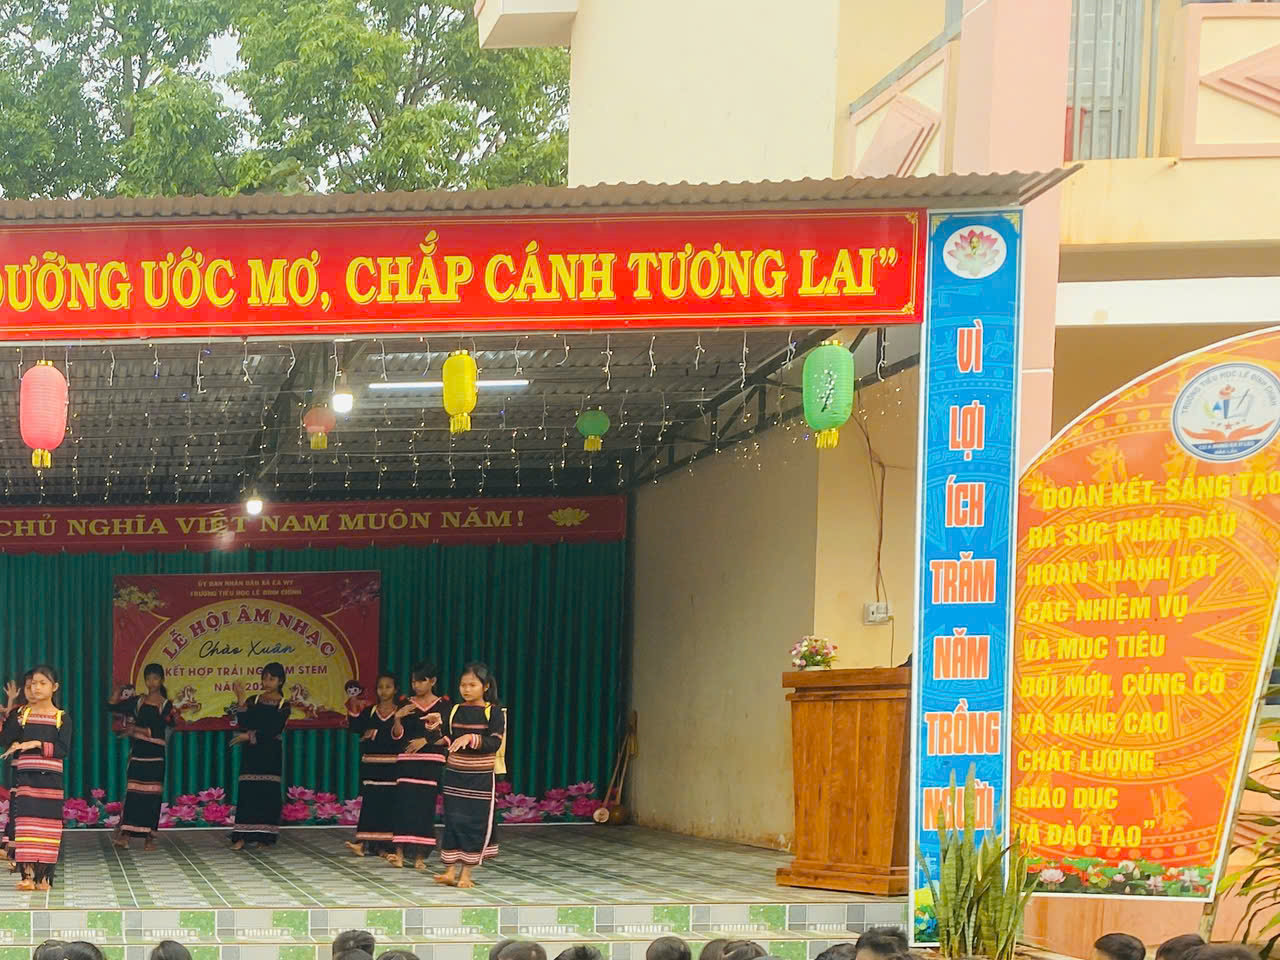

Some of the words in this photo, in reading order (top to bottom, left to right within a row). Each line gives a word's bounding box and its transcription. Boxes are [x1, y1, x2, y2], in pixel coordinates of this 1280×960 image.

[141, 245, 237, 309] ƯỚC
[248, 249, 331, 312] MƠ,
[345, 229, 475, 304] CHẮP
[484, 239, 618, 303] CÁNH
[626, 242, 789, 299] TƯƠNG
[797, 246, 898, 297] LAI”
[949, 400, 986, 461] LỢI
[945, 474, 986, 528] ÍCH
[1112, 473, 1158, 505] KẾT,
[1165, 473, 1232, 501] SÁNG
[1239, 470, 1280, 501] TẠO
[66, 513, 169, 537] NGHĨA
[175, 511, 252, 536] VIỆT
[260, 513, 330, 532] NAM
[338, 508, 432, 531] MUÔN
[1028, 525, 1056, 549] RA
[1064, 519, 1109, 546] SỨC
[1116, 510, 1180, 543] PHẤN
[930, 551, 997, 605] TRĂM
[1026, 558, 1088, 586] HOÀN
[1095, 554, 1170, 583] THÀNH
[1177, 546, 1221, 579] TỐT
[1024, 596, 1070, 624] CÁC
[1076, 592, 1152, 625] NHIỆM
[1158, 594, 1189, 623] VỤ
[162, 629, 189, 660] LỄ
[189, 611, 231, 638] HỘI
[236, 604, 271, 624] ÂM
[276, 611, 337, 657] NHẠC
[199, 640, 243, 659] Chào
[247, 640, 297, 657] Xuân
[1022, 632, 1051, 661] VÀ
[1057, 635, 1109, 665] MỤC
[1115, 630, 1166, 659] TIÊU
[165, 664, 185, 677] KẾT
[188, 665, 214, 679] HỢP
[298, 664, 328, 675] STEM
[933, 627, 991, 681] NĂM
[1020, 667, 1058, 699] ĐỔI
[1064, 670, 1114, 699] MỚI,
[1122, 665, 1187, 696] CỦNG
[1193, 664, 1226, 695] CỐ
[924, 698, 1001, 756] TRỒNG
[1018, 708, 1047, 736] VÀ
[1053, 708, 1117, 735] NÂNG
[1124, 711, 1170, 735] CAO
[1017, 742, 1074, 772] CHẤT
[1079, 748, 1155, 776] LƯỢNG
[1015, 780, 1067, 809] GIÁO
[1073, 786, 1119, 814] DỤC
[1047, 819, 1093, 847] ĐÀO
